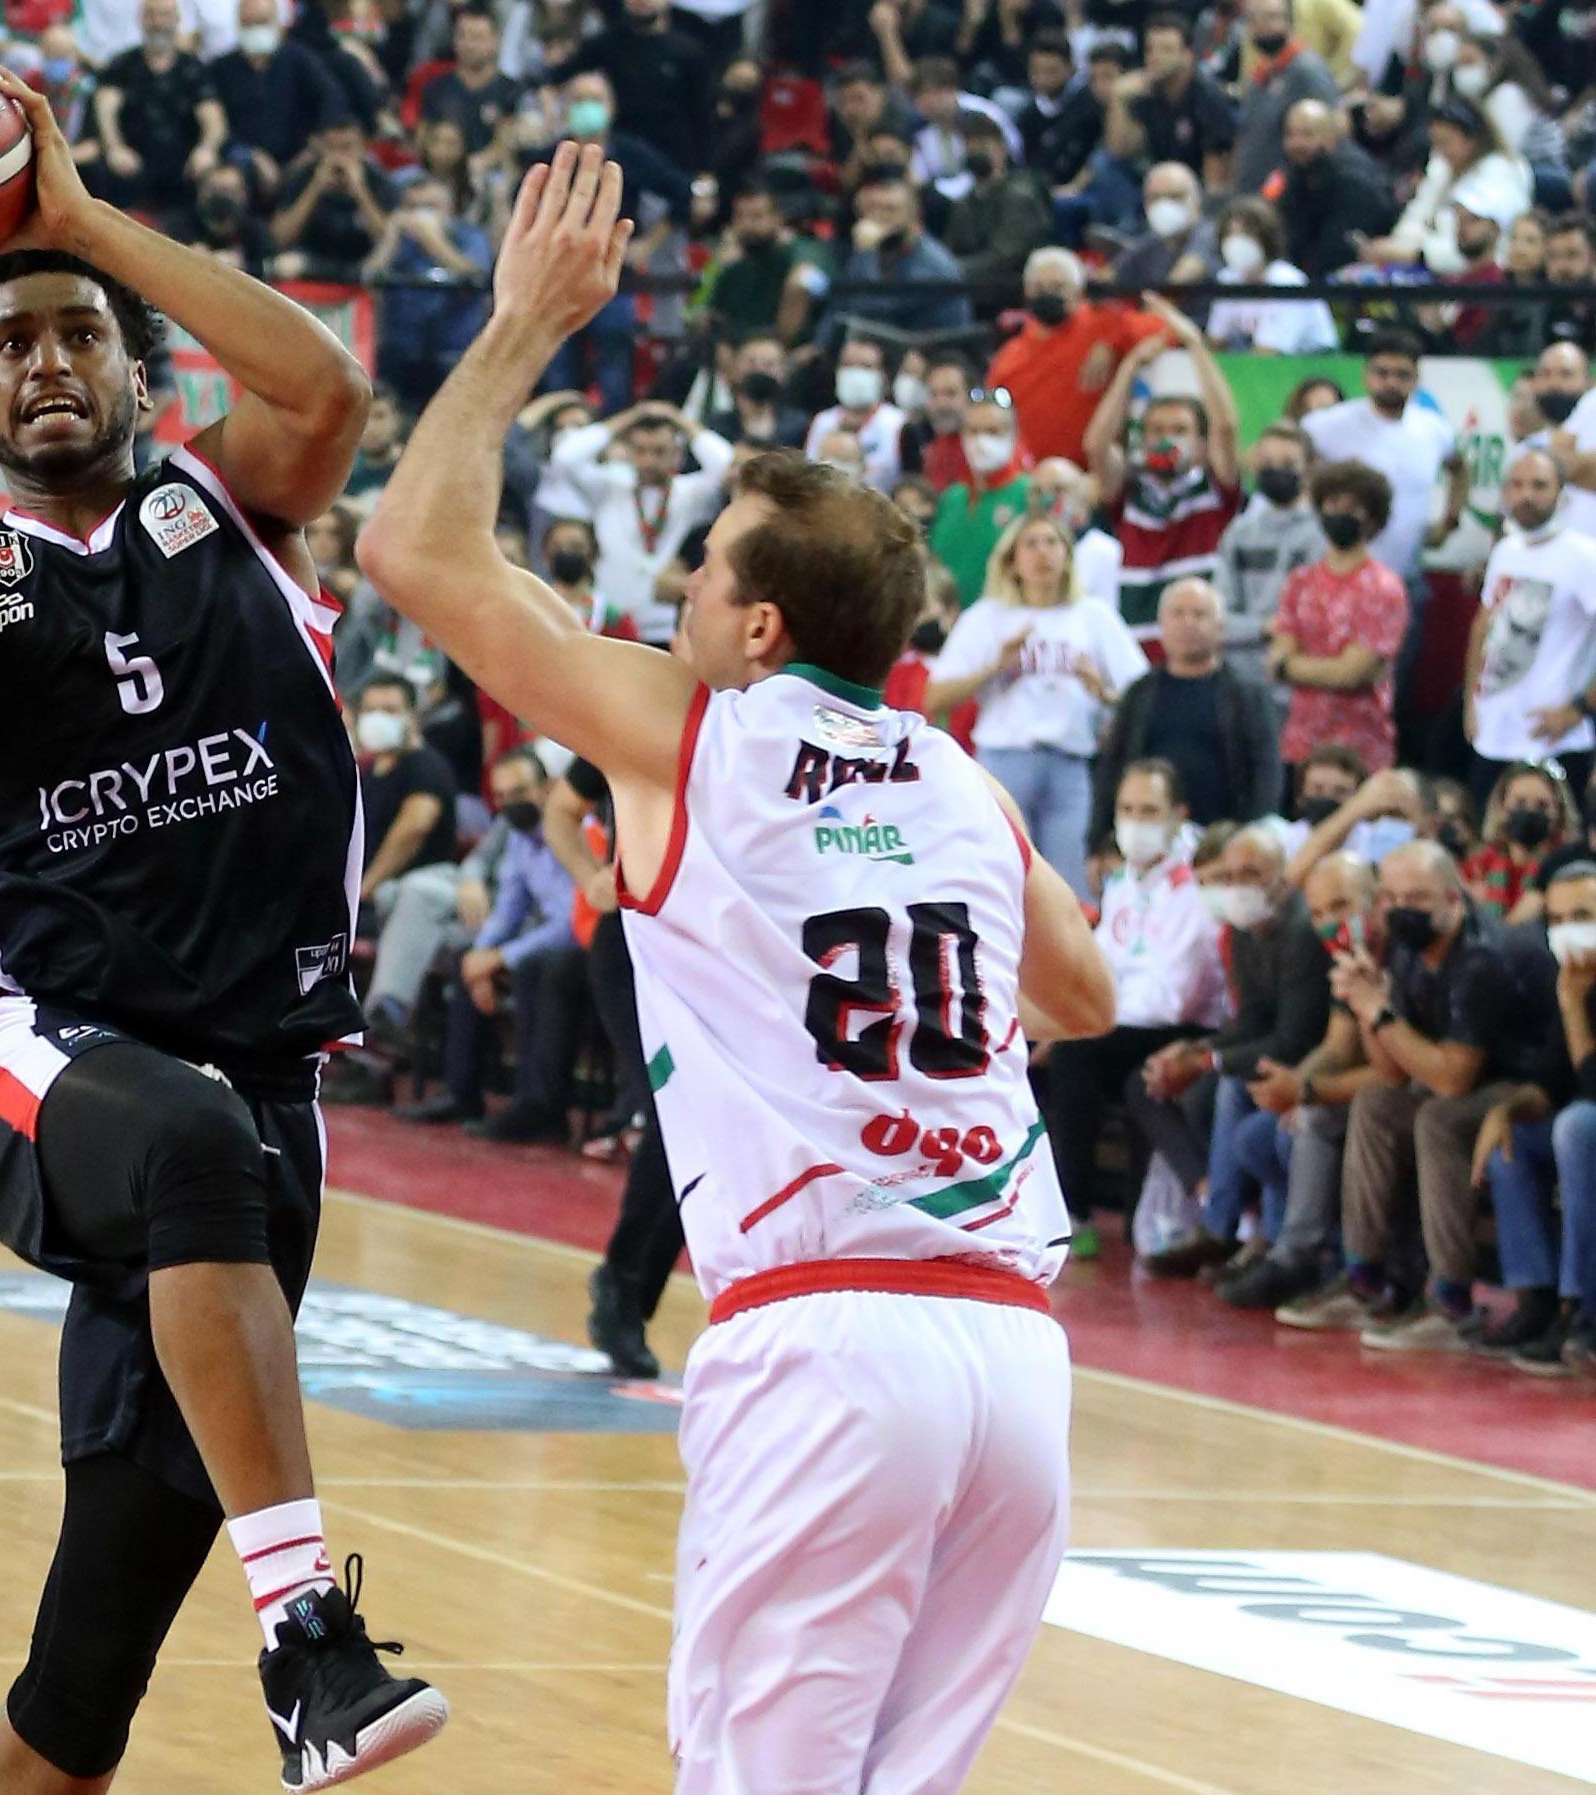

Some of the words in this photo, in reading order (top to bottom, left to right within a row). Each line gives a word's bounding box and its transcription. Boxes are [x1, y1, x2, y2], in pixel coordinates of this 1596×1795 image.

[104, 630, 164, 715] 5
[38, 720, 274, 831] ICRYPEX
[47, 814, 139, 852] CRYPTO
[147, 774, 279, 828] EXCHANGE
[802, 902, 991, 1082] 20
